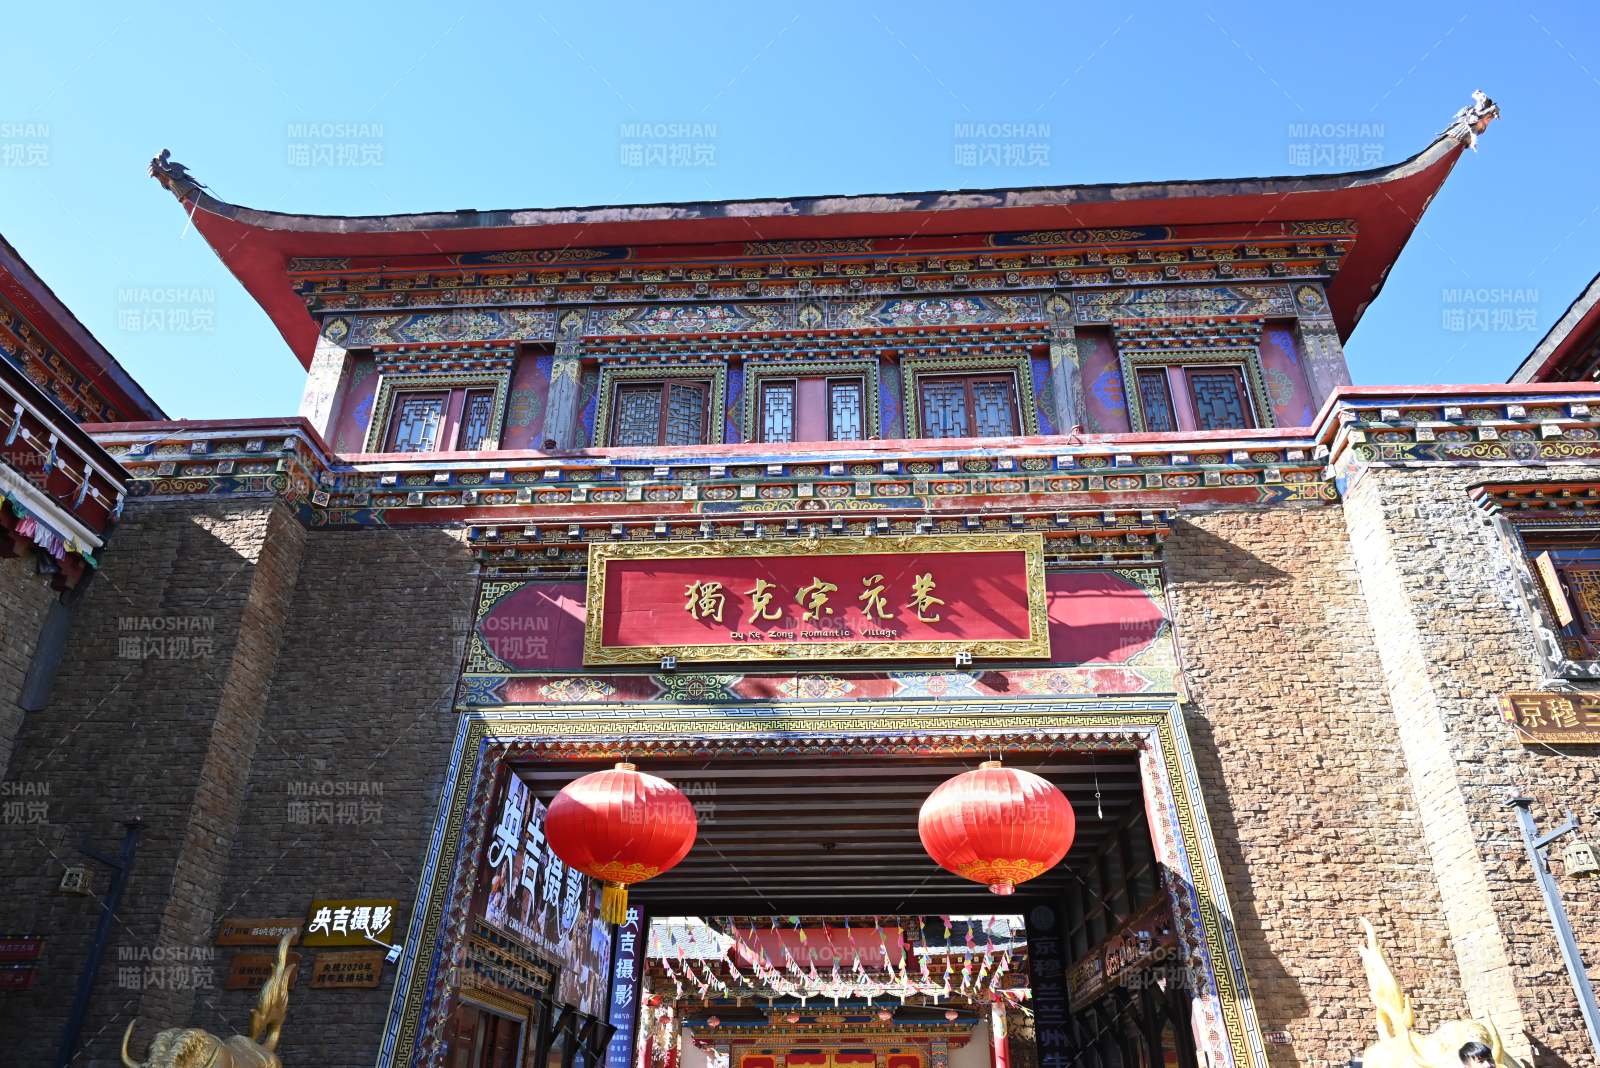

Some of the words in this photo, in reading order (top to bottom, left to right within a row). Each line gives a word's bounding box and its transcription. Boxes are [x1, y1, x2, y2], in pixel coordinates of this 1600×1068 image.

[684, 572, 945, 624] 獨克宗花巷
[768, 630, 795, 639] Zong
[800, 629, 850, 638] Romantic
[858, 628, 898, 638] Village
[309, 906, 392, 939] 央吉摄影
[614, 906, 640, 1009] 央吉摄影
